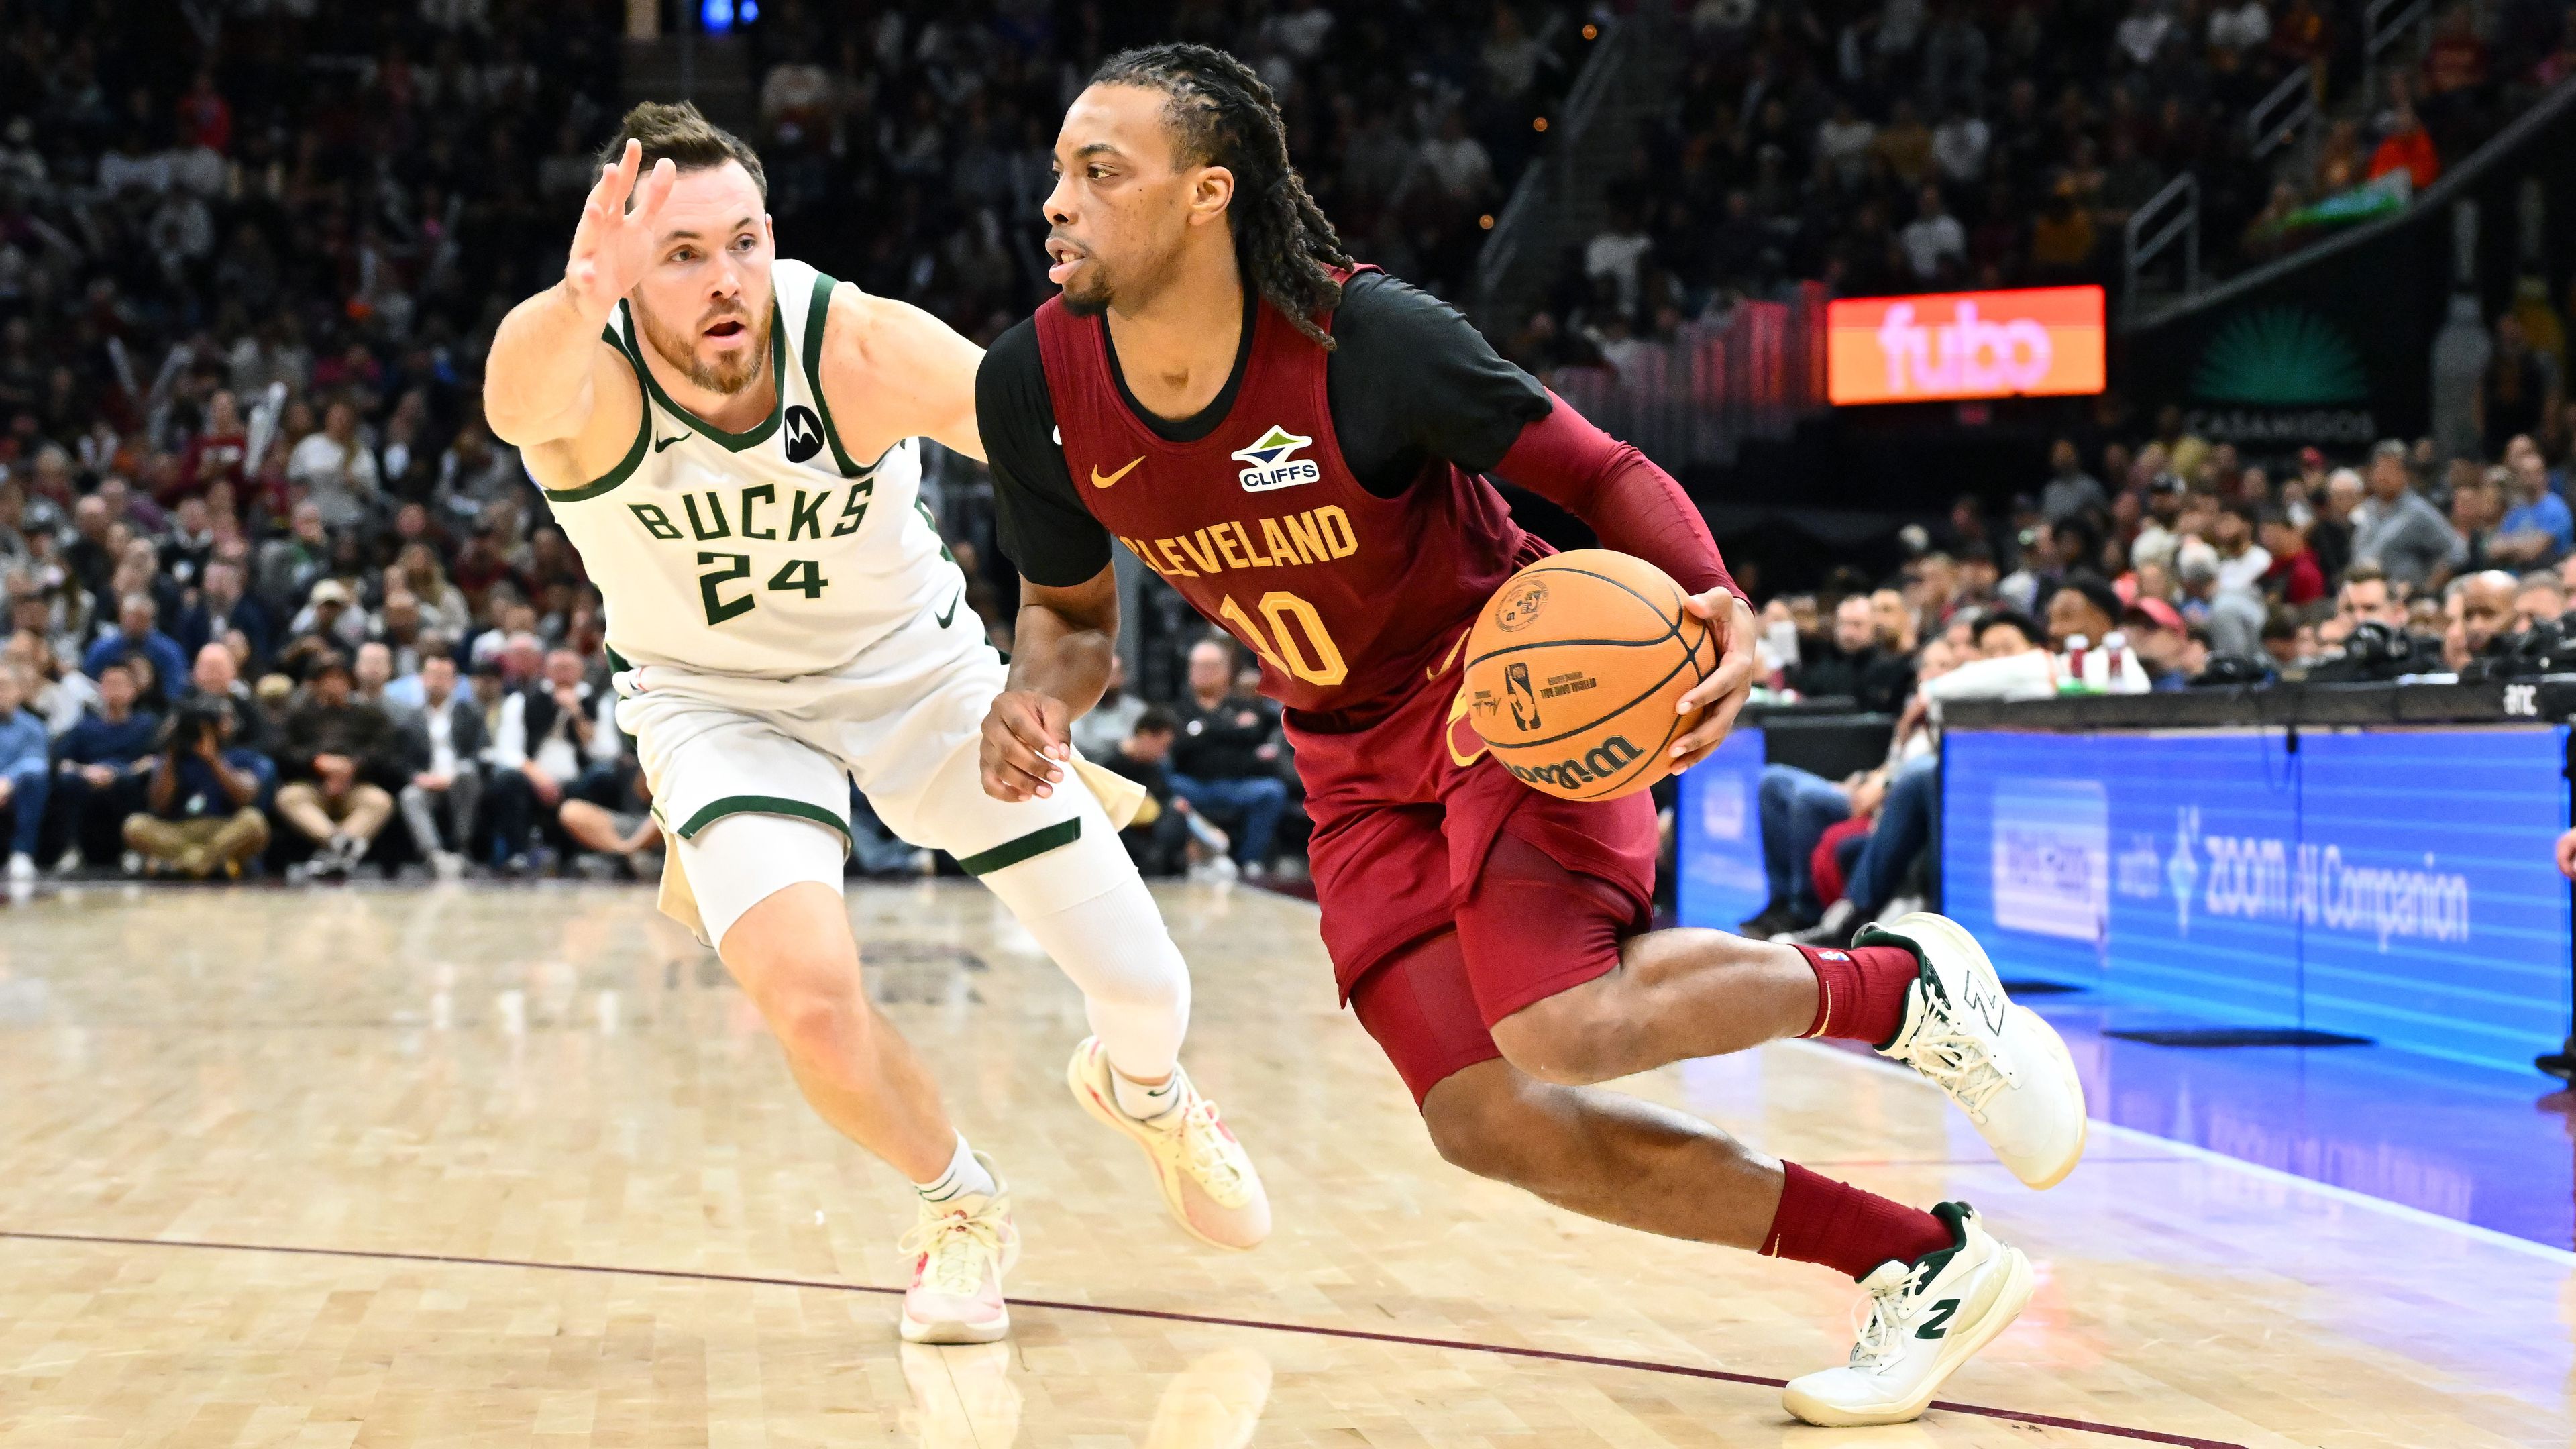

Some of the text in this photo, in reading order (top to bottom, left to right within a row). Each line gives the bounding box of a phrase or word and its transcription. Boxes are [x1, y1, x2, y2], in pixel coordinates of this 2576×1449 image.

[1878, 300, 2053, 394] fubo
[628, 476, 874, 541] BUCKS
[1244, 464, 1317, 486] CLIFFS
[696, 551, 829, 626] 24
[1219, 591, 1349, 686] 10
[1501, 735, 1646, 790] Wilso
[2205, 835, 2288, 918] zoom
[2292, 843, 2318, 925] AI
[2321, 843, 2469, 953] Companion
